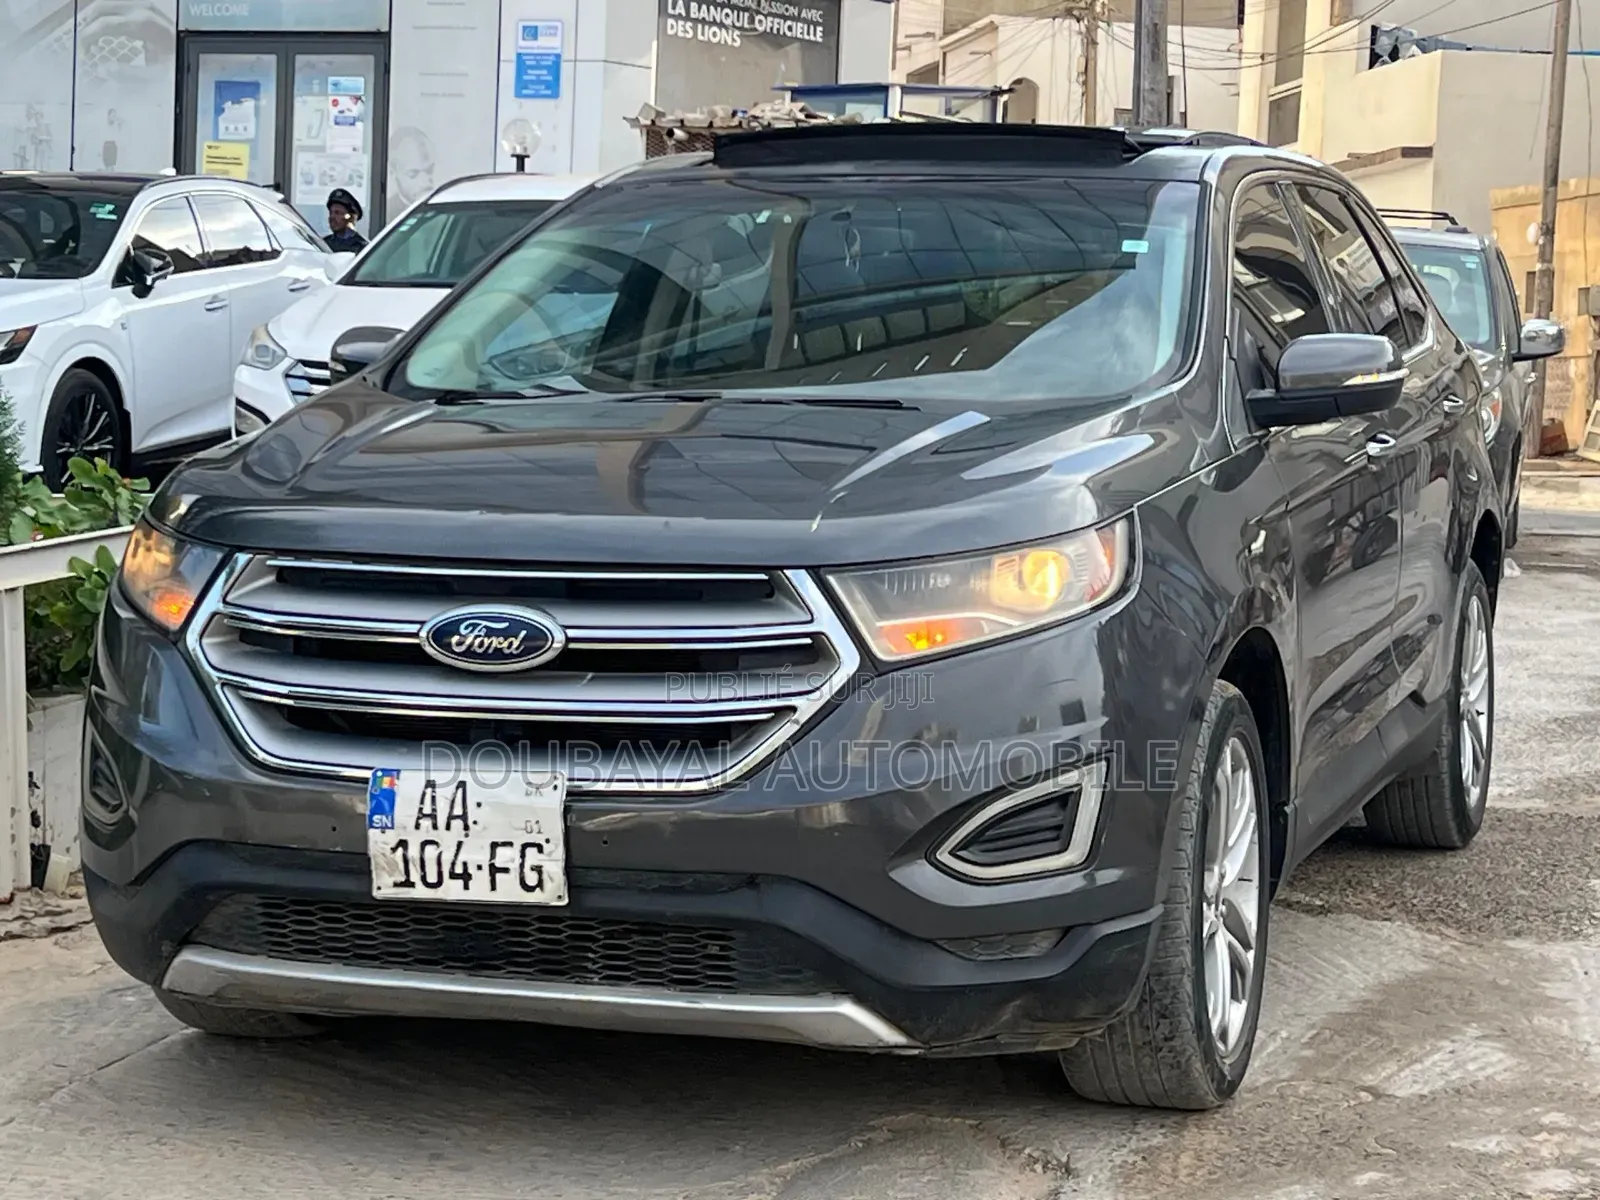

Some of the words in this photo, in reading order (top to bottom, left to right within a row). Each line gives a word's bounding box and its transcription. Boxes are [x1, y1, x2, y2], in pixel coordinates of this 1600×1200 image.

[189, 2, 249, 17] WELCOME
[667, 0, 686, 17] LA
[755, 15, 824, 43] OFFICIELLE
[800, 8, 824, 22] AVEC
[666, 18, 694, 39] DES
[697, 25, 741, 48] LIONS
[451, 619, 527, 655] Ford
[414, 779, 470, 831] AA
[372, 814, 392, 828] SN
